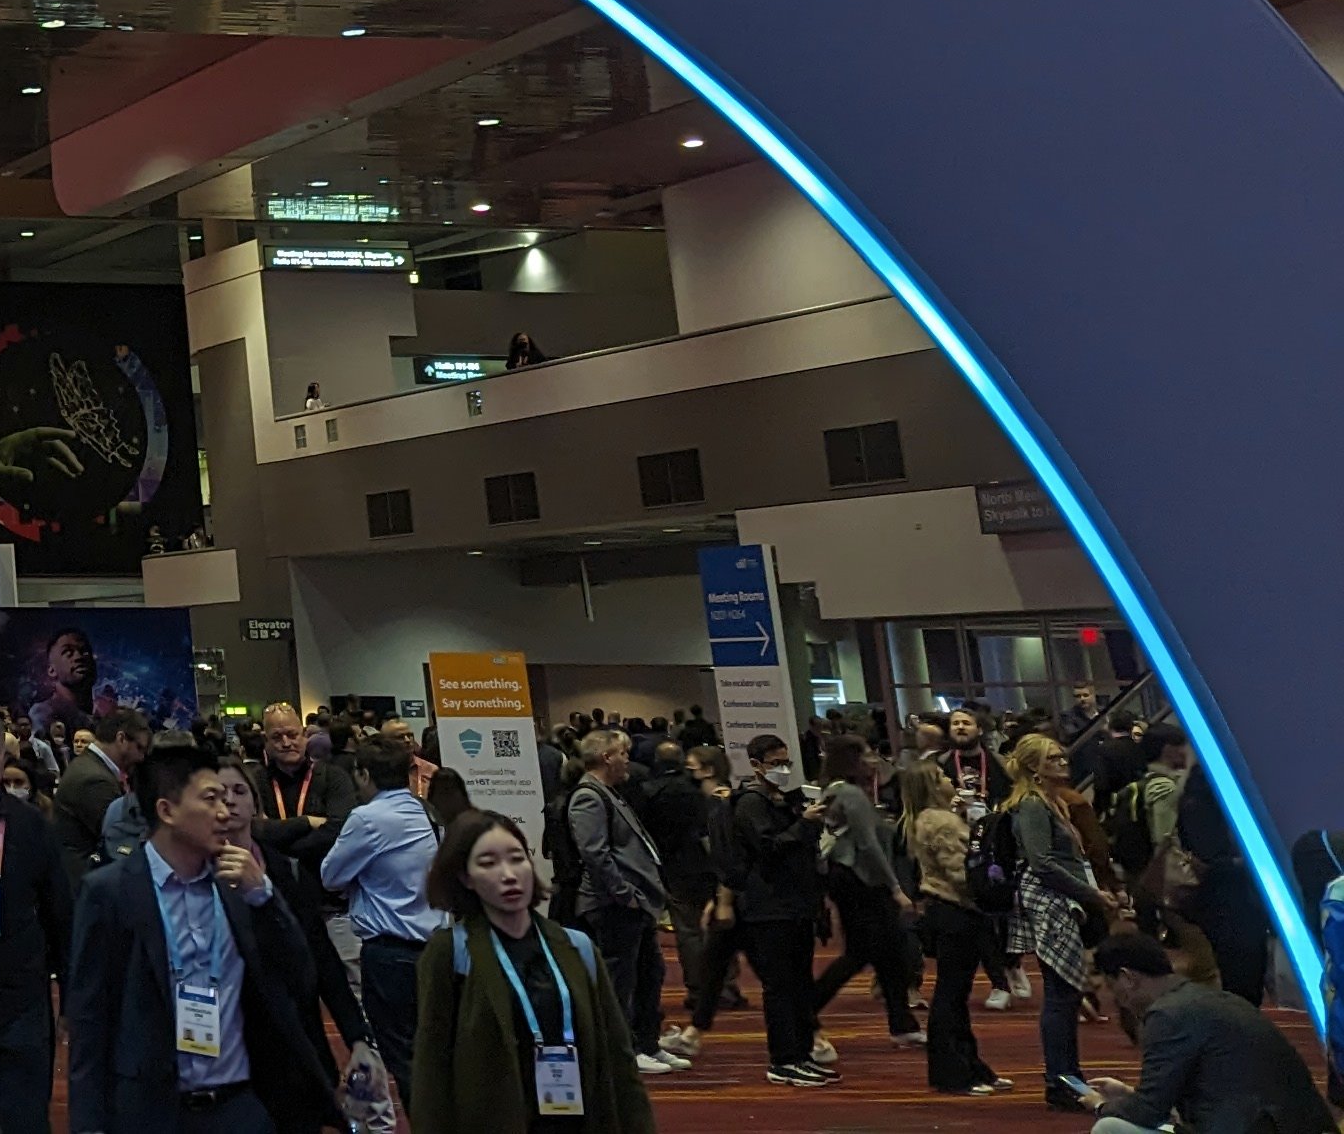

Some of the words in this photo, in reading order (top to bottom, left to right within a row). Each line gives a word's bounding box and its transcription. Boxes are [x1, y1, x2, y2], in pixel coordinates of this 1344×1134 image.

[248, 620, 292, 630] Elevator
[439, 678, 460, 690] See
[461, 677, 522, 692] something.
[441, 697, 461, 711] Say
[463, 697, 525, 711] something.
